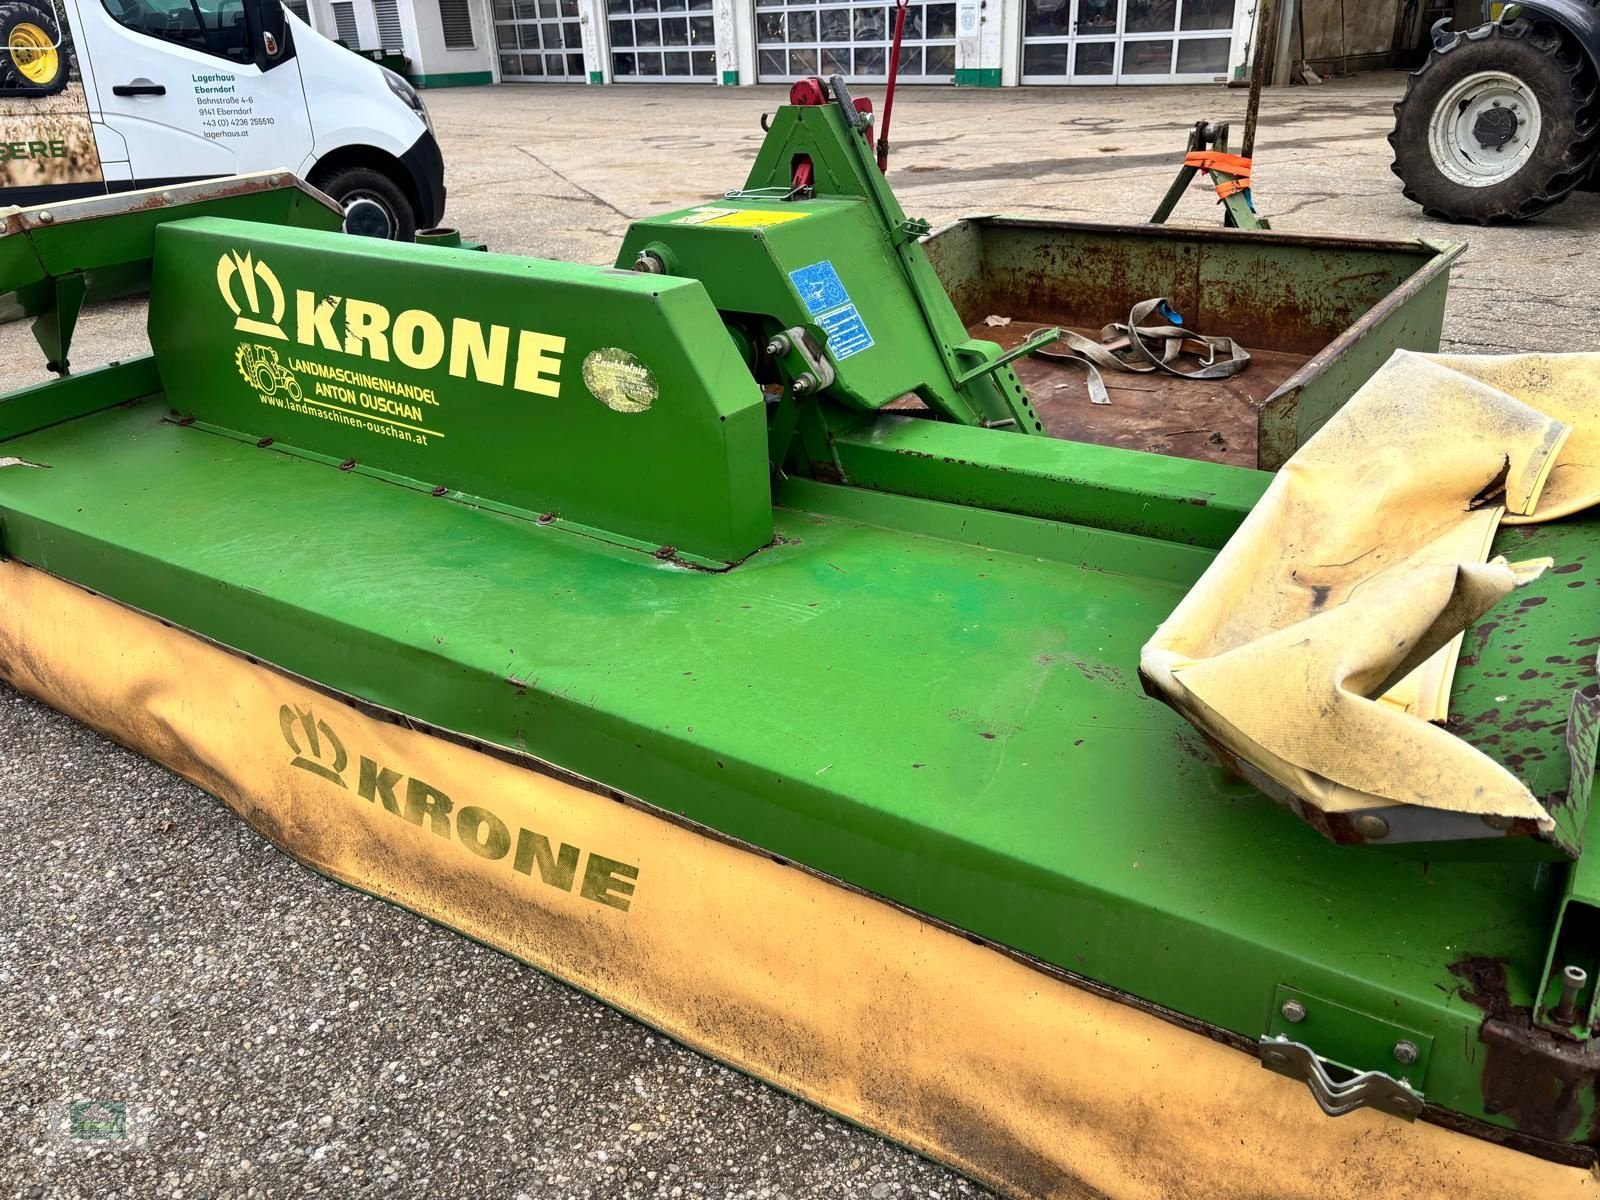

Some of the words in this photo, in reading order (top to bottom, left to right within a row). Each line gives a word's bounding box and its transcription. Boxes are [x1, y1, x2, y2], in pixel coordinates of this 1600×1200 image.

[192, 73, 236, 83] Lagerhaus
[194, 85, 235, 94] Eberndorf
[196, 97, 239, 105] Bahnstraße
[241, 96, 254, 104] 4-6
[199, 108, 215, 116] 9141
[217, 107, 252, 115] Eberndorf
[202, 119, 216, 127] +43
[217, 119, 229, 127] (0)
[231, 118, 249, 126] 4236
[250, 117, 275, 126] 255510
[204, 130, 249, 139] lagerhaus.at
[296, 289, 567, 398] KRONE
[288, 357, 440, 406] LANDMASCHINENHANDEL
[315, 382, 357, 405] ANTON
[359, 392, 423, 422] OUSCHAN
[259, 394, 428, 446] www.landmaschinen-ouschan.at
[358, 755, 640, 913] KRONE
